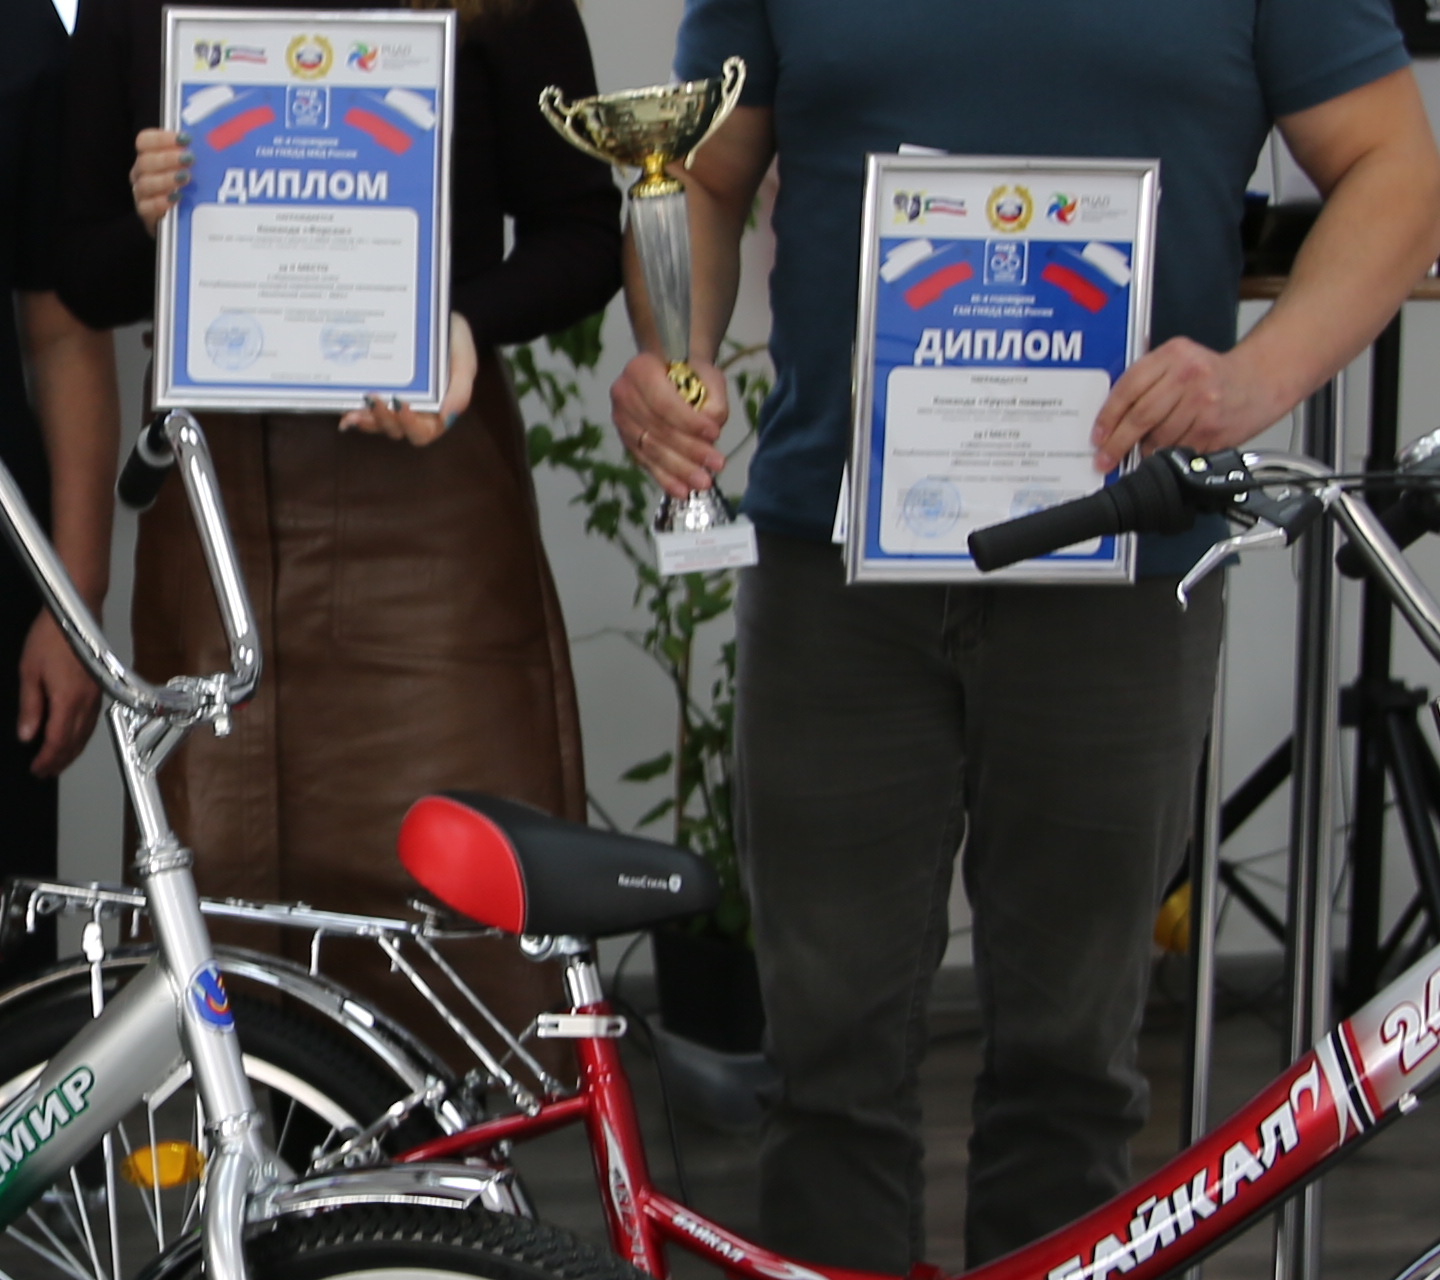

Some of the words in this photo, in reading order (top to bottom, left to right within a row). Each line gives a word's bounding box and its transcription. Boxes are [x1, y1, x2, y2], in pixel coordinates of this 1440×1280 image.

[216, 167, 389, 205] ДИПЛОМ
[913, 328, 1083, 367] ДИПЛОМ
[672, 1212, 746, 1263] БАЙКАЛ
